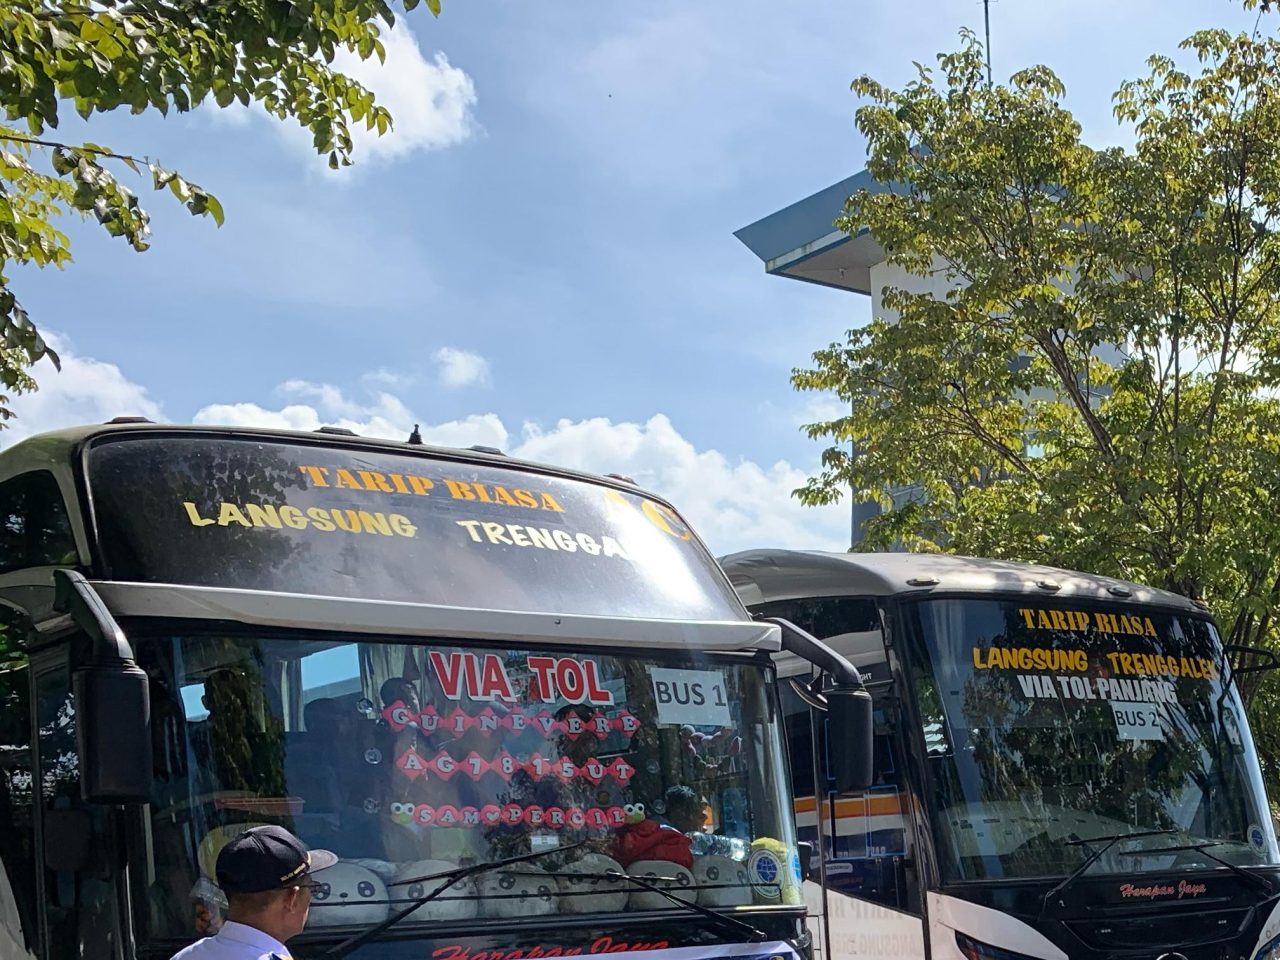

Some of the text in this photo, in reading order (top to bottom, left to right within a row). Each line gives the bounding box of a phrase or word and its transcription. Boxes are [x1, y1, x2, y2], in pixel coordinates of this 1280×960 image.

[298, 464, 566, 513] TARIP BIASA
[183, 502, 636, 561] LANGSUNG TRENGGA
[1019, 608, 1158, 637] TARIP BIASA
[973, 647, 1220, 680] LANGSUNG TRENGGALEK
[429, 651, 614, 706] VIA TOL
[1016, 675, 1178, 703] VIA TOL PANJANG
[656, 681, 728, 708] BUS 1
[392, 707, 638, 735] GUINEVERE
[1116, 711, 1160, 727] BUS 2
[420, 805, 479, 825] SAM
[1119, 879, 1207, 900] Harapan Jaya
